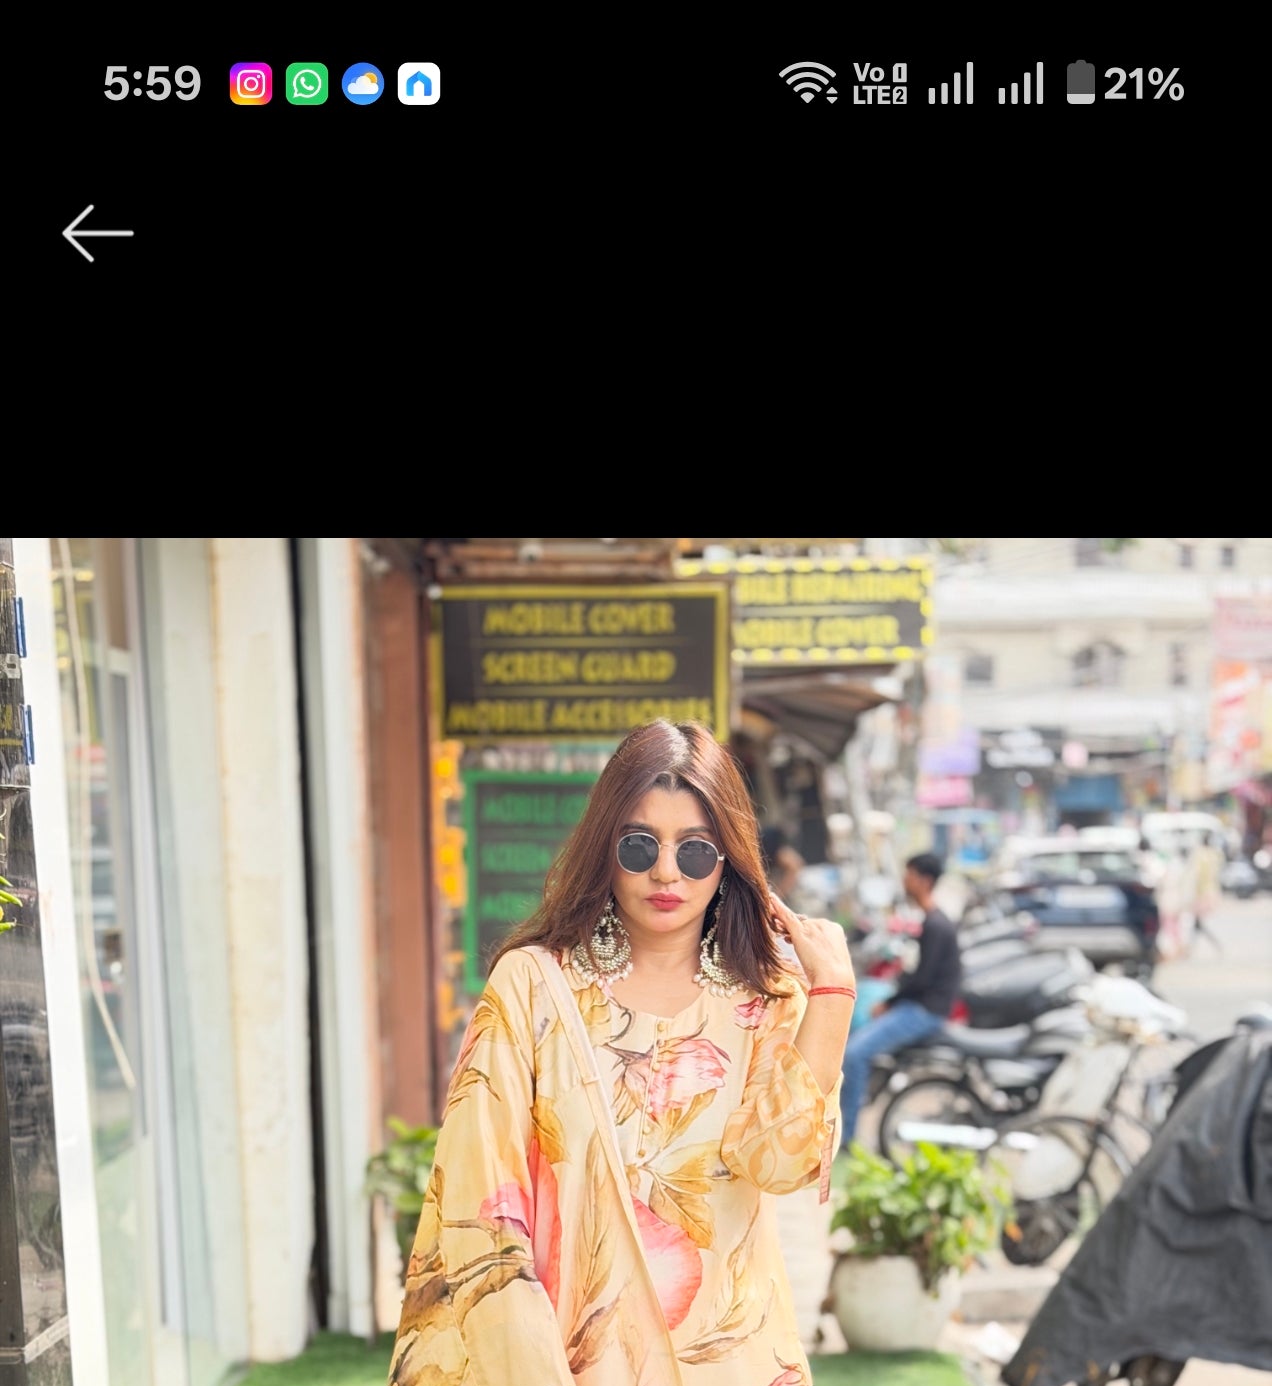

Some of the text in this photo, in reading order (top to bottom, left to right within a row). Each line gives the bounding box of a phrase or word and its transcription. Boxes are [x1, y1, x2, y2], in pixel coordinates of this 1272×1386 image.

[483, 602, 676, 636] MOBILE COVER
[815, 615, 899, 647] COVER
[482, 651, 677, 684] SCREEN GUARD
[449, 700, 547, 732] MOBILE
